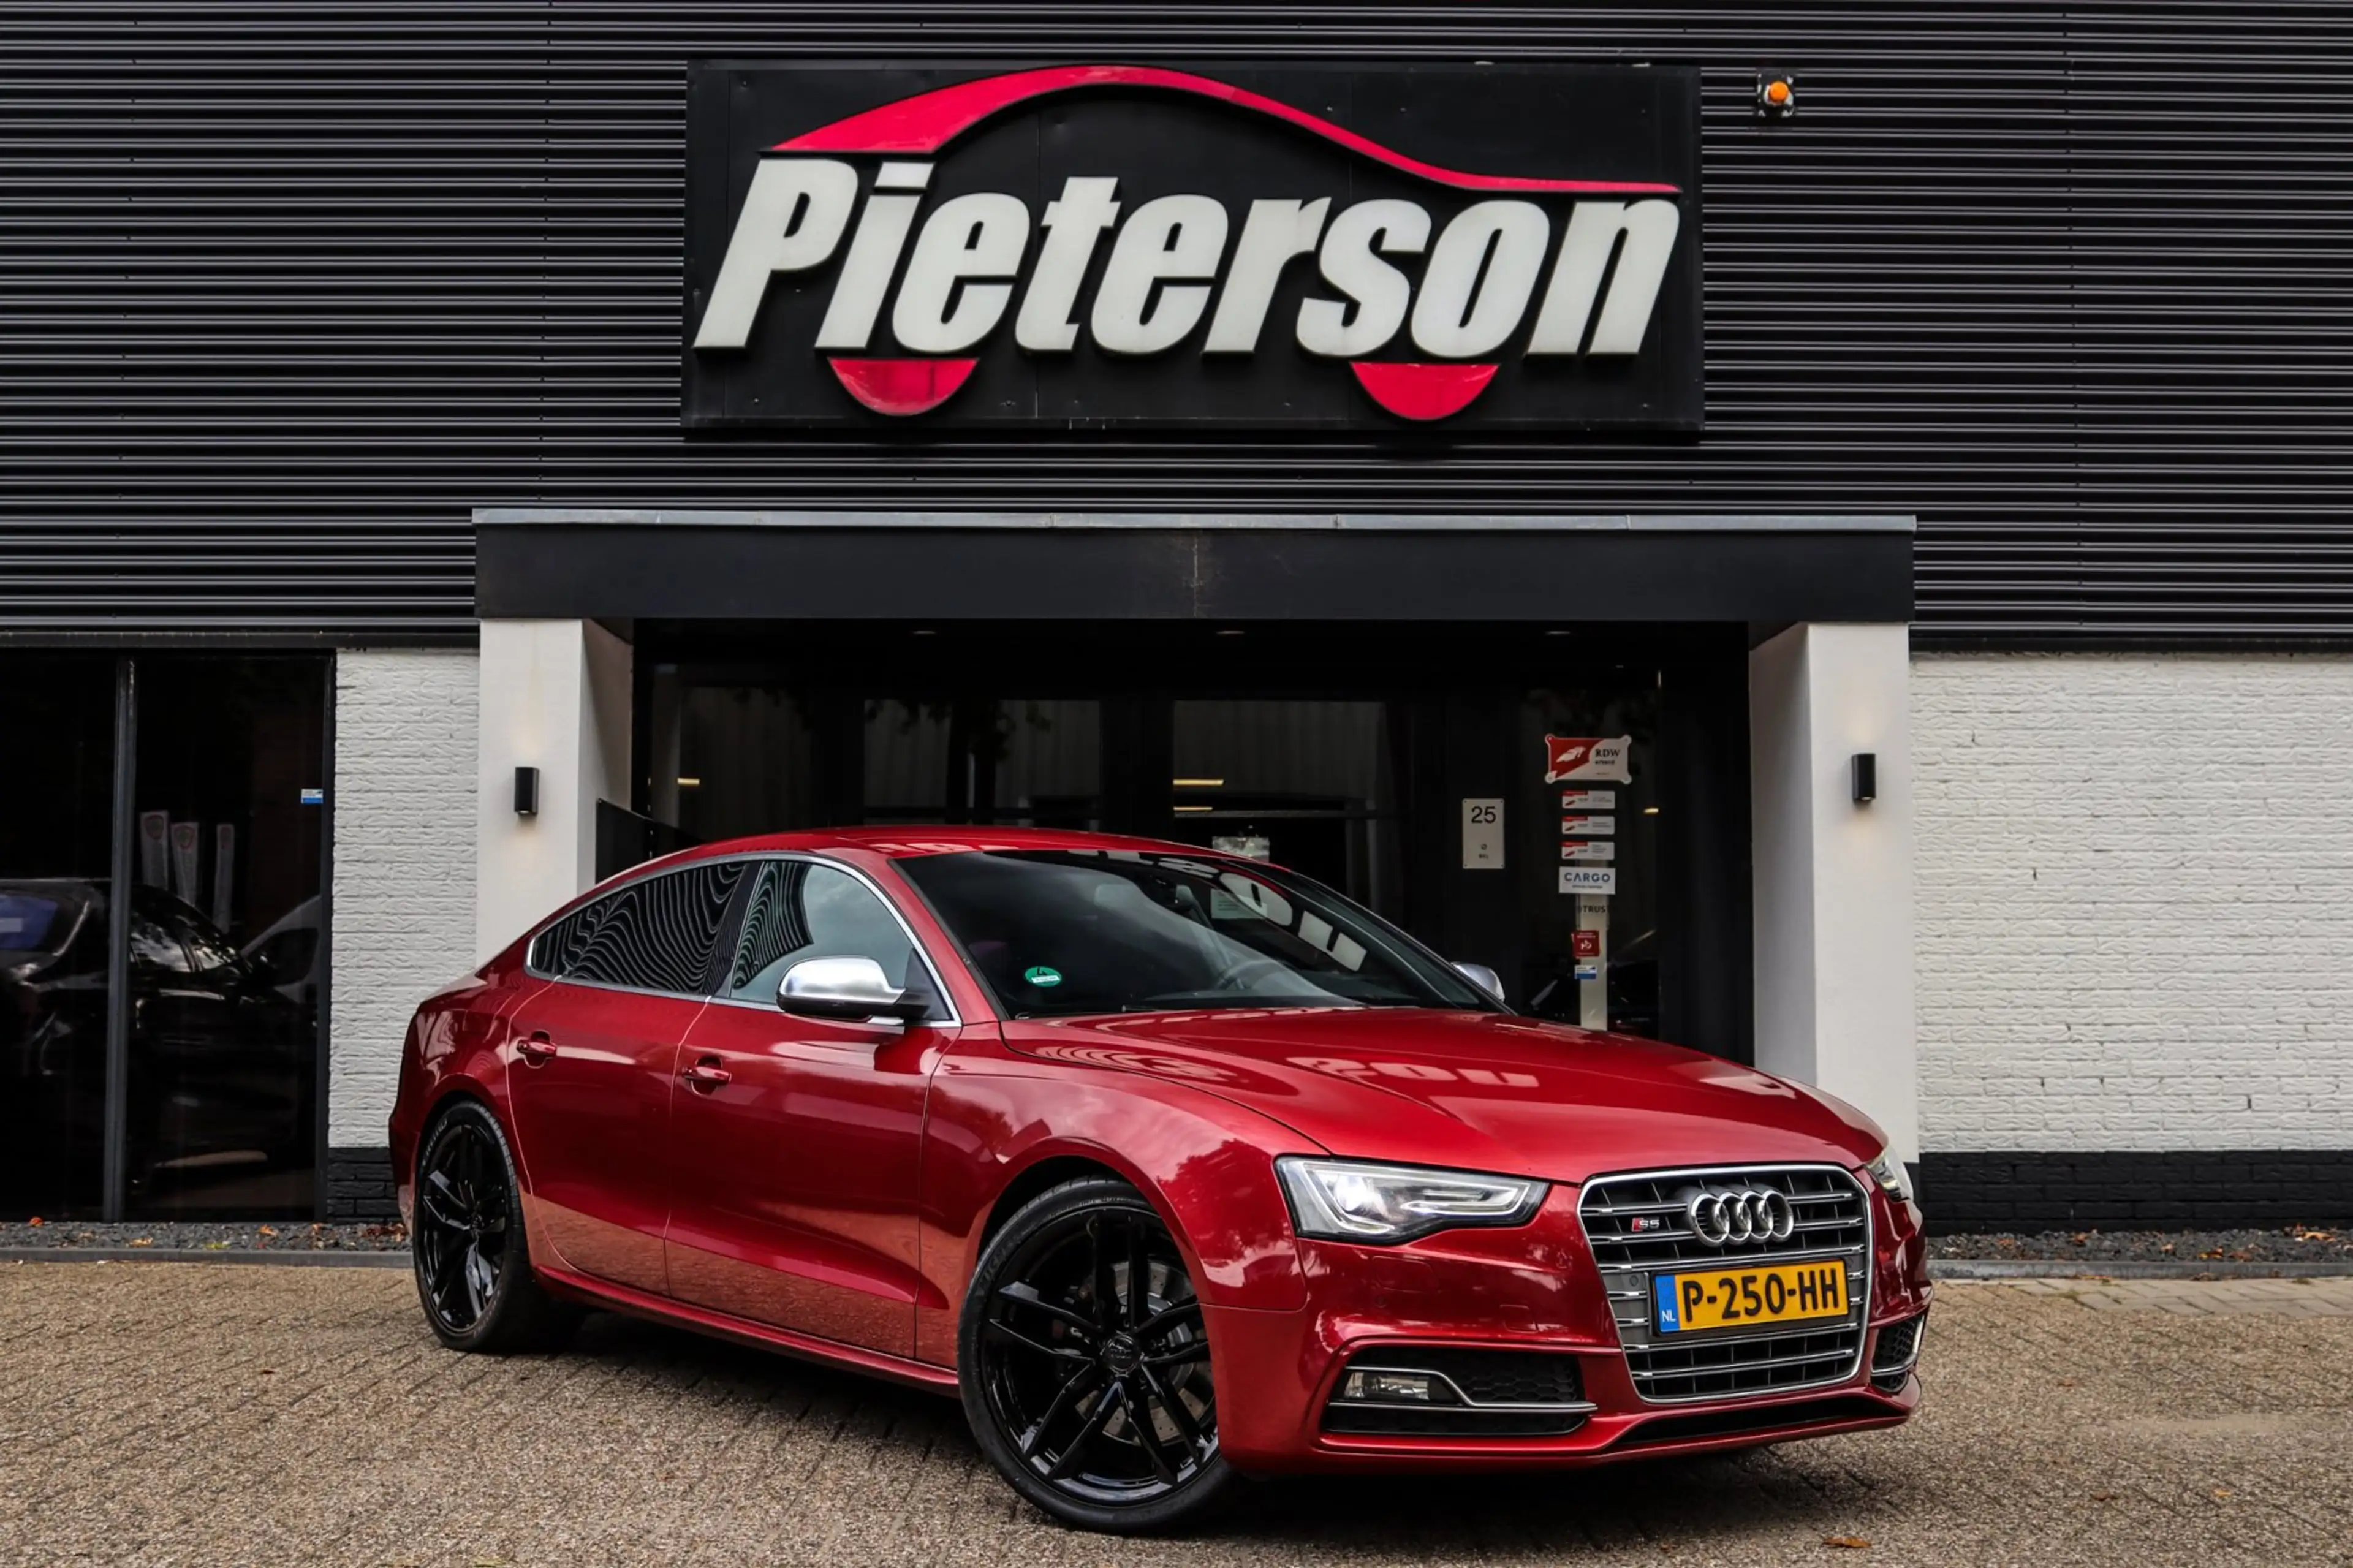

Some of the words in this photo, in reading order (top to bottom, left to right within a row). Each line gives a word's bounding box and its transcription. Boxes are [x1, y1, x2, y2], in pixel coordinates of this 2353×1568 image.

[692, 158, 1681, 357] Pieterson
[1595, 748, 1621, 757] RDW
[1471, 805, 1496, 824] 25
[1564, 872, 1611, 882] CARGO
[1640, 1219, 1660, 1229] S5
[1682, 1267, 1839, 1322] P-250-HH
[1662, 1309, 1676, 1323] NL
